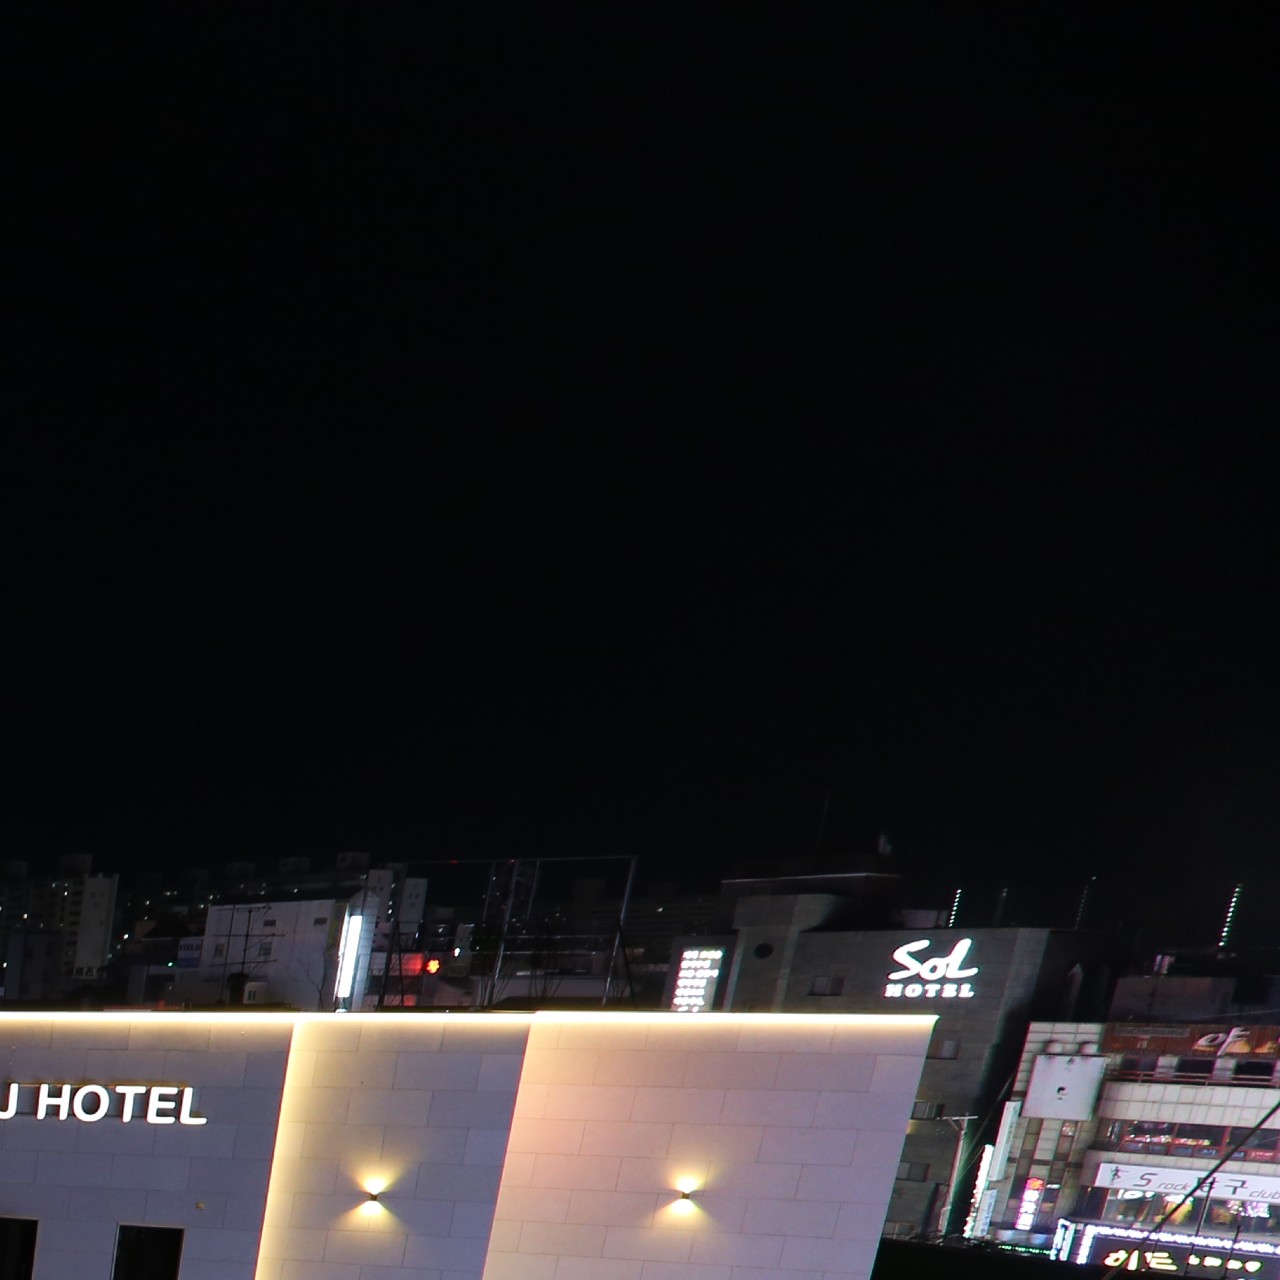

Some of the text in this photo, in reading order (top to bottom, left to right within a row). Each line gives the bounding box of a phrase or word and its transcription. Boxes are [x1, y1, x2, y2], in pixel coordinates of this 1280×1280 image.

[887, 938, 979, 980] Sol
[883, 983, 975, 998] HOTEL
[36, 1083, 208, 1125] HOTEL
